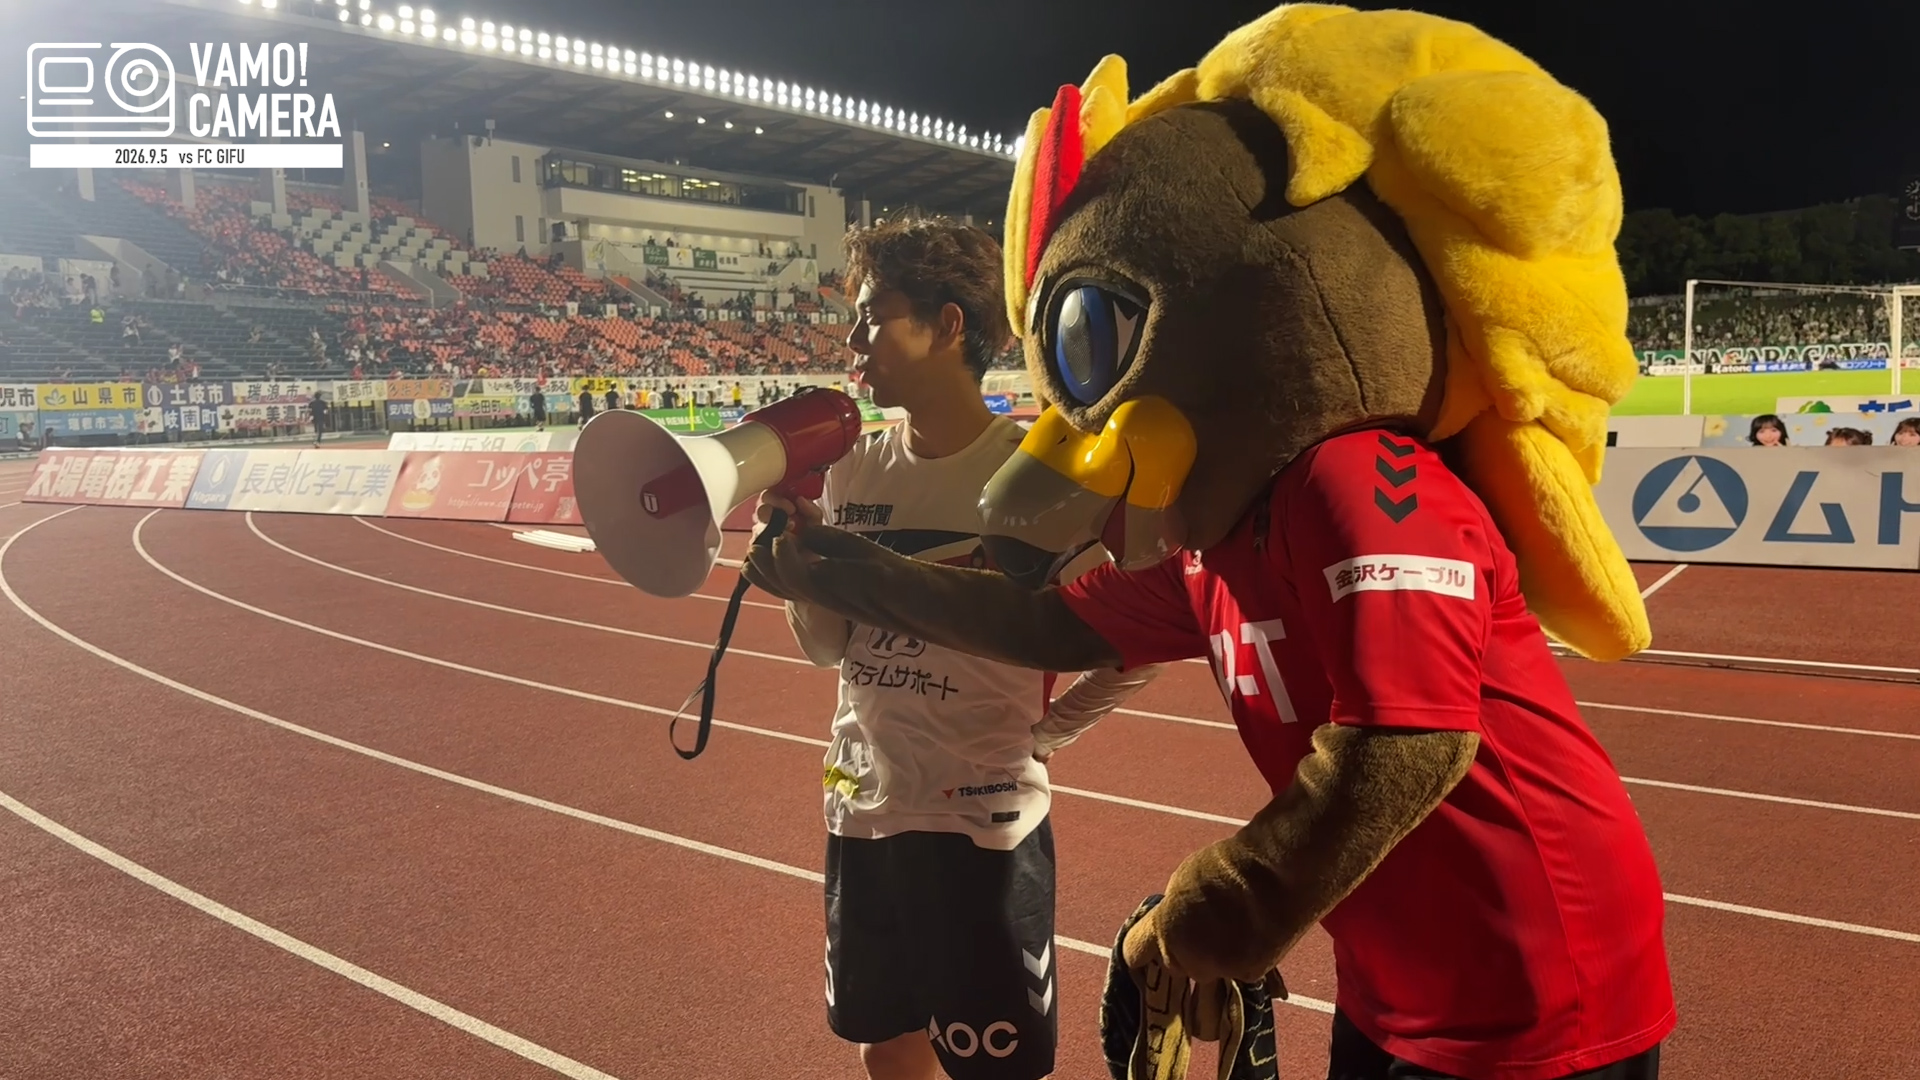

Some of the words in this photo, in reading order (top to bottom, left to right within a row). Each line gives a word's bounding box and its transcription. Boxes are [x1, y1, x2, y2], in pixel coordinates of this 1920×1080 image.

[73, 386, 136, 405] 山県市
[170, 384, 224, 405] 土岐市
[247, 383, 300, 402] 瑞浪市
[164, 408, 217, 429] 岐南町
[240, 464, 392, 497] 長良化学工業
[468, 456, 573, 493] コッペ亭
[1334, 563, 1467, 591] 金沢ケーブル
